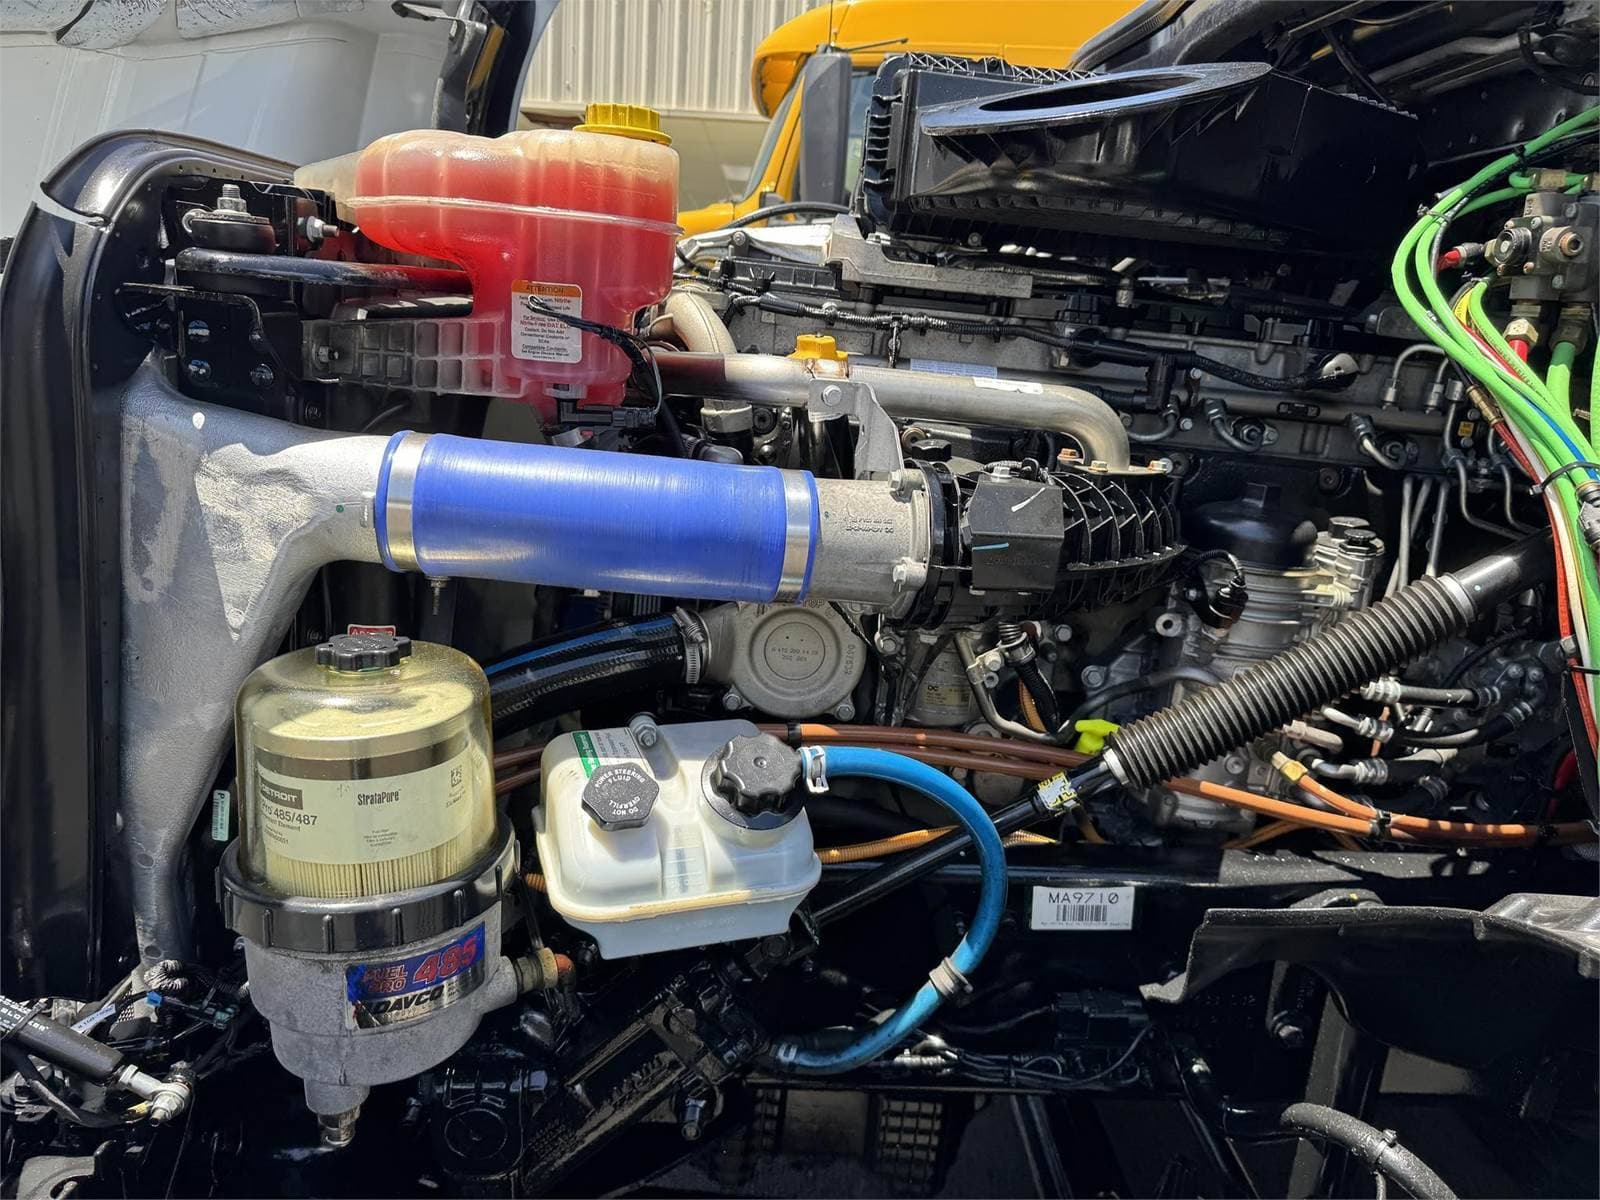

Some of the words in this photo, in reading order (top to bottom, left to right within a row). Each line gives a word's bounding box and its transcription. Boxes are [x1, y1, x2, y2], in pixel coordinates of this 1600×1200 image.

[526, 285, 564, 294] ATTENTION
[594, 770, 614, 788] POWER
[614, 767, 646, 783] STEERING
[607, 775, 631, 784] FLUID
[357, 790, 399, 806] StrataPore
[608, 795, 641, 810] OVERFILL
[273, 807, 318, 826] 485/487
[612, 808, 627, 816] NOT
[628, 806, 639, 815] DO
[1048, 891, 1119, 904] MA9710
[412, 935, 478, 984] 485
[364, 964, 408, 982] FUEL
[368, 978, 407, 992] PRO
